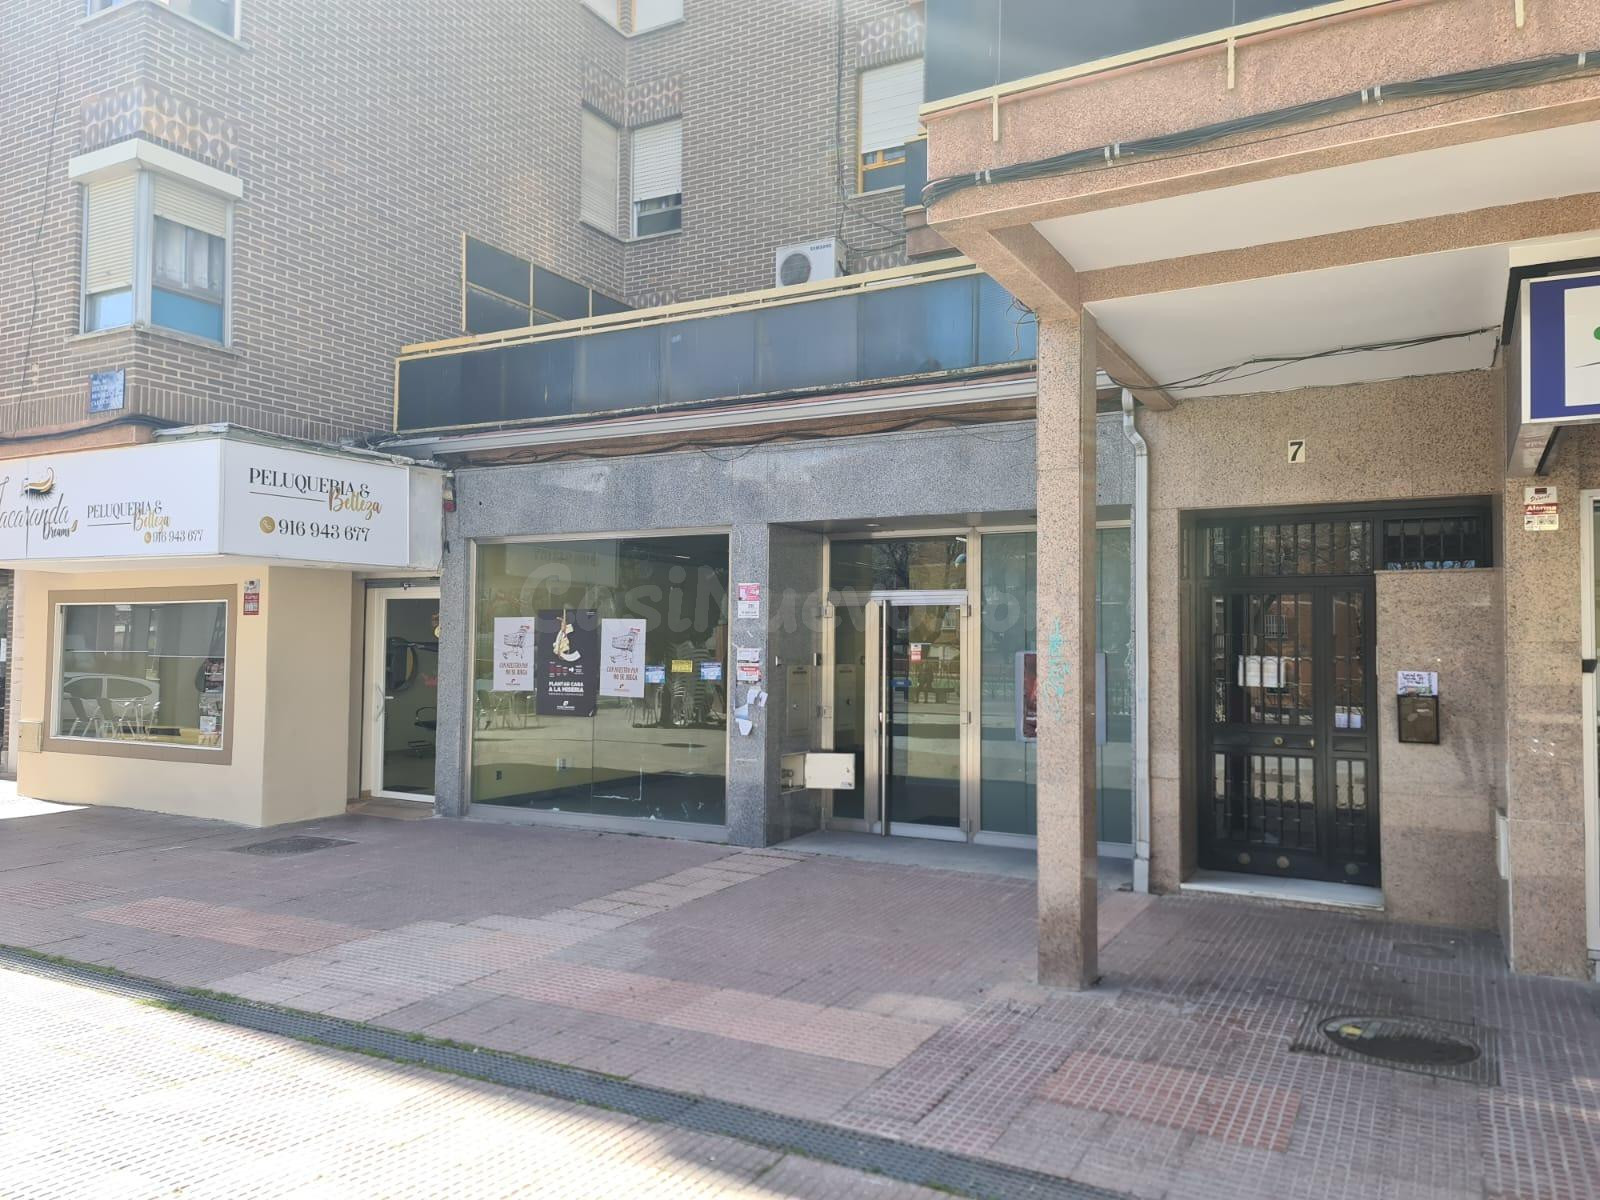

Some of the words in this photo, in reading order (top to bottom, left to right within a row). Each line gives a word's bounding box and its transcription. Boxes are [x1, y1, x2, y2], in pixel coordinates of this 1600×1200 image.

[1290, 441, 1303, 461] 7
[249, 467, 354, 495] PELUQUERIA
[360, 483, 370, 498] &
[88, 501, 151, 519] PELUQUERIA
[154, 500, 162, 514] &
[328, 487, 382, 520] Belleza
[133, 508, 169, 535] Belleza
[278, 519, 305, 537] 916
[310, 522, 340, 539] 943
[345, 526, 371, 541] 677
[152, 531, 166, 543] 916
[168, 530, 185, 542] 943
[187, 529, 203, 542] 677
